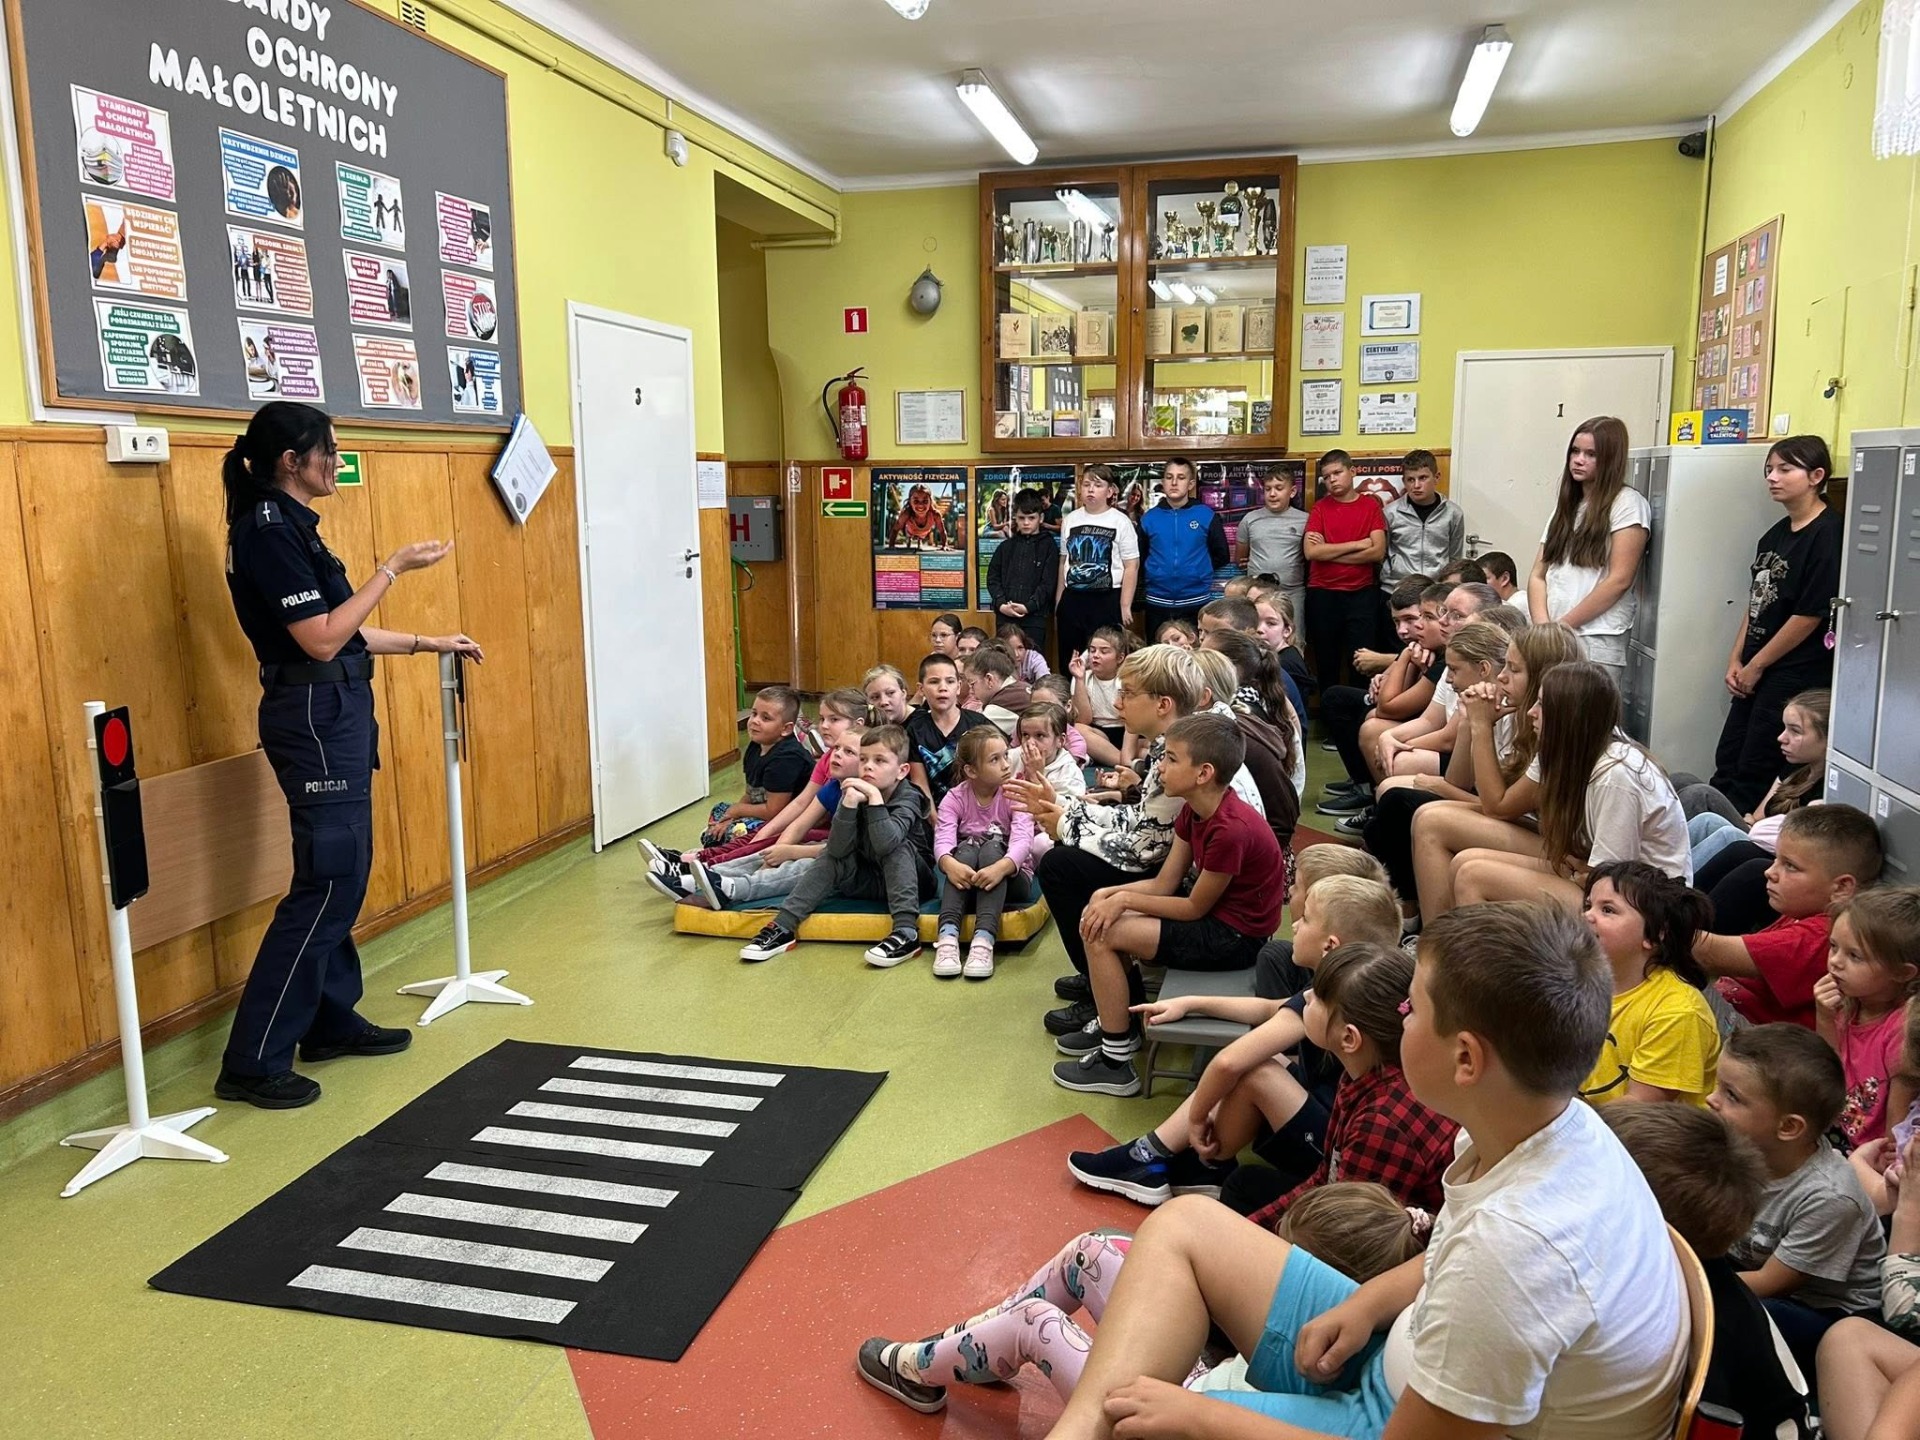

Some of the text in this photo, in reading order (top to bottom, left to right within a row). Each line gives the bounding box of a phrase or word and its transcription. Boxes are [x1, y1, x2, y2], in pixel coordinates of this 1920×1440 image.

[247, 27, 397, 117] OCHRONY
[99, 97, 147, 119] STANDARDY
[149, 42, 387, 158] MAŁOLETNICH
[104, 110, 144, 128] OCHRONY
[472, 300, 491, 316] STOP
[1365, 345, 1399, 353] CERTYFIKAT
[635, 387, 642, 406] 3
[878, 473, 923, 481] AKTYWNOŚĆ
[730, 513, 751, 542] H
[281, 589, 322, 609] POLICJA
[305, 779, 348, 793] POLICJA
